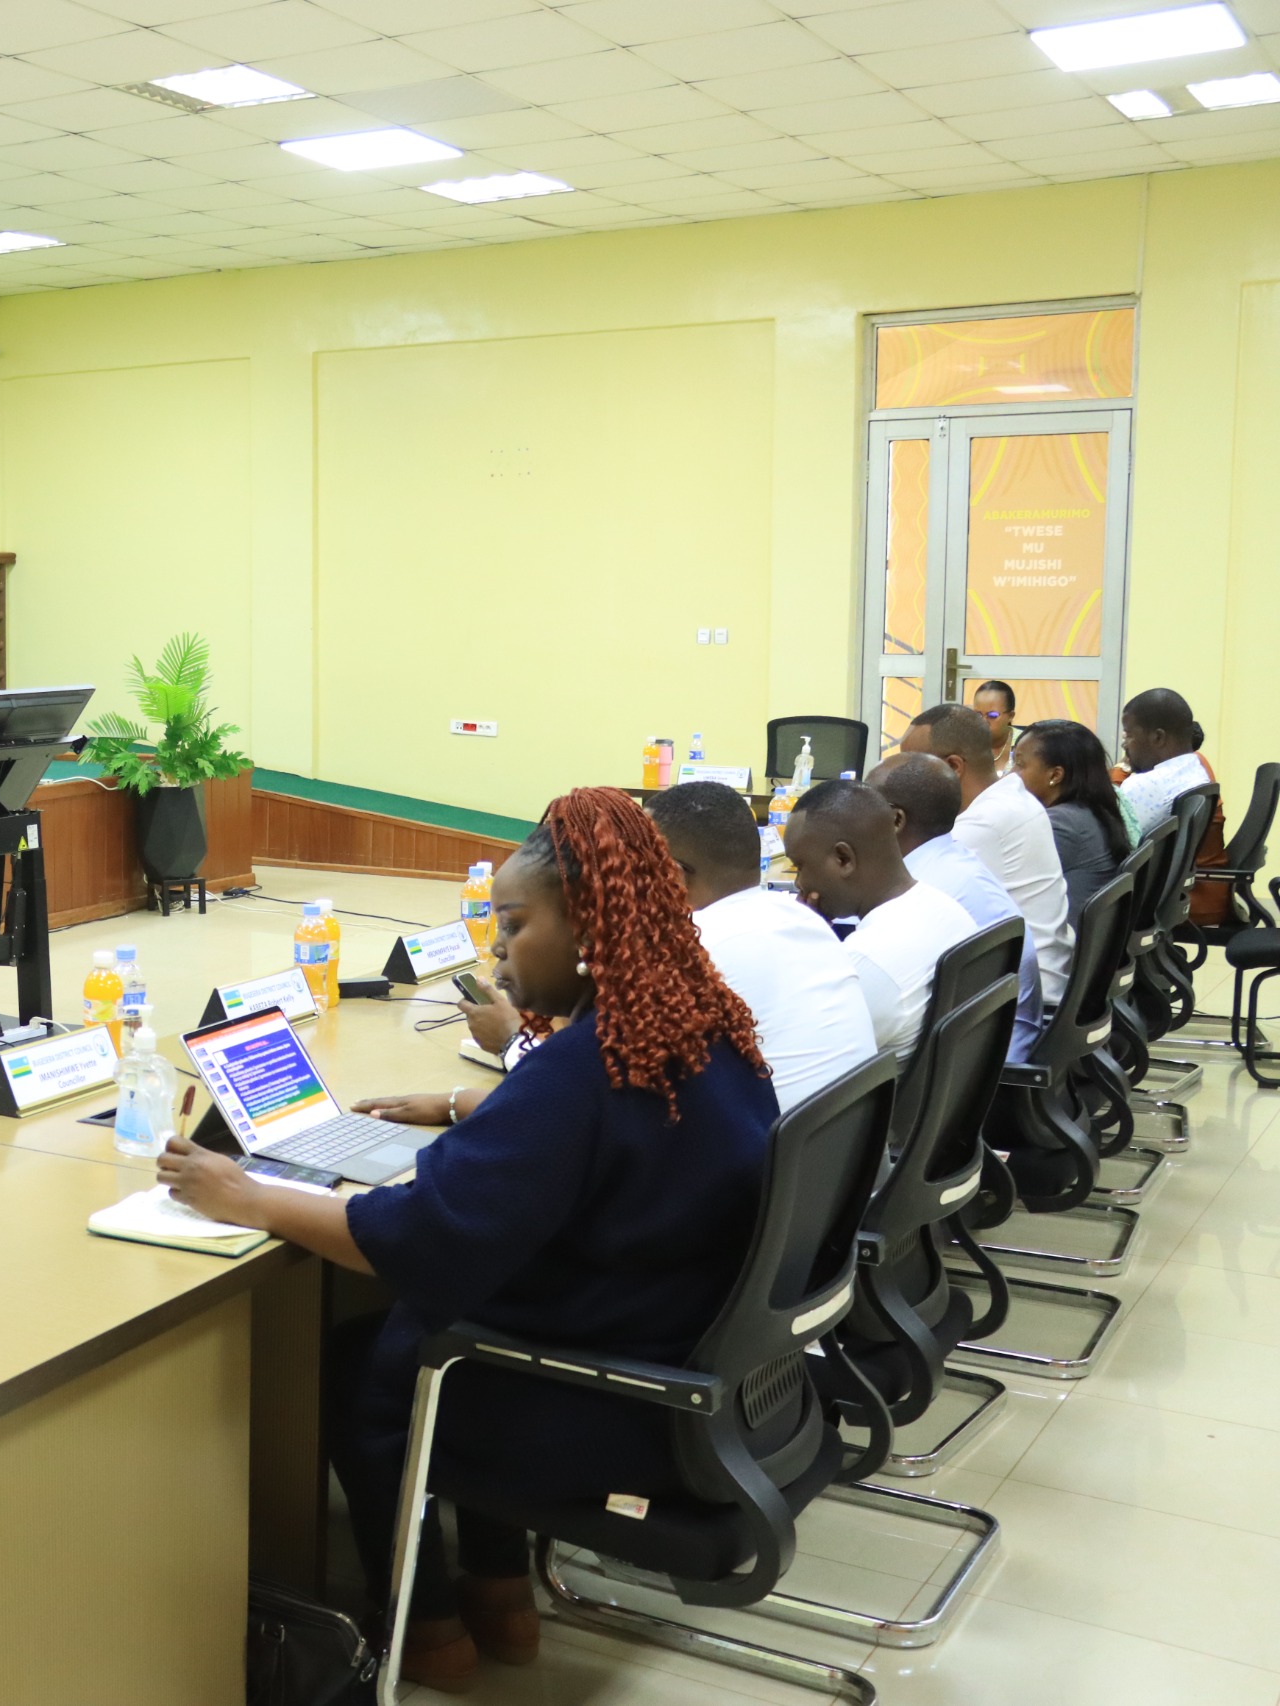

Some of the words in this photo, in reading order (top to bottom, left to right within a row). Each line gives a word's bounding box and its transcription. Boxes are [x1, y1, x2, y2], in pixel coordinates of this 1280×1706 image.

[1022, 542, 1044, 553] MU
[1004, 559, 1062, 570] MUJISHI
[80, 1060, 97, 1070] Yvette
[58, 1075, 86, 1089] Councillor
